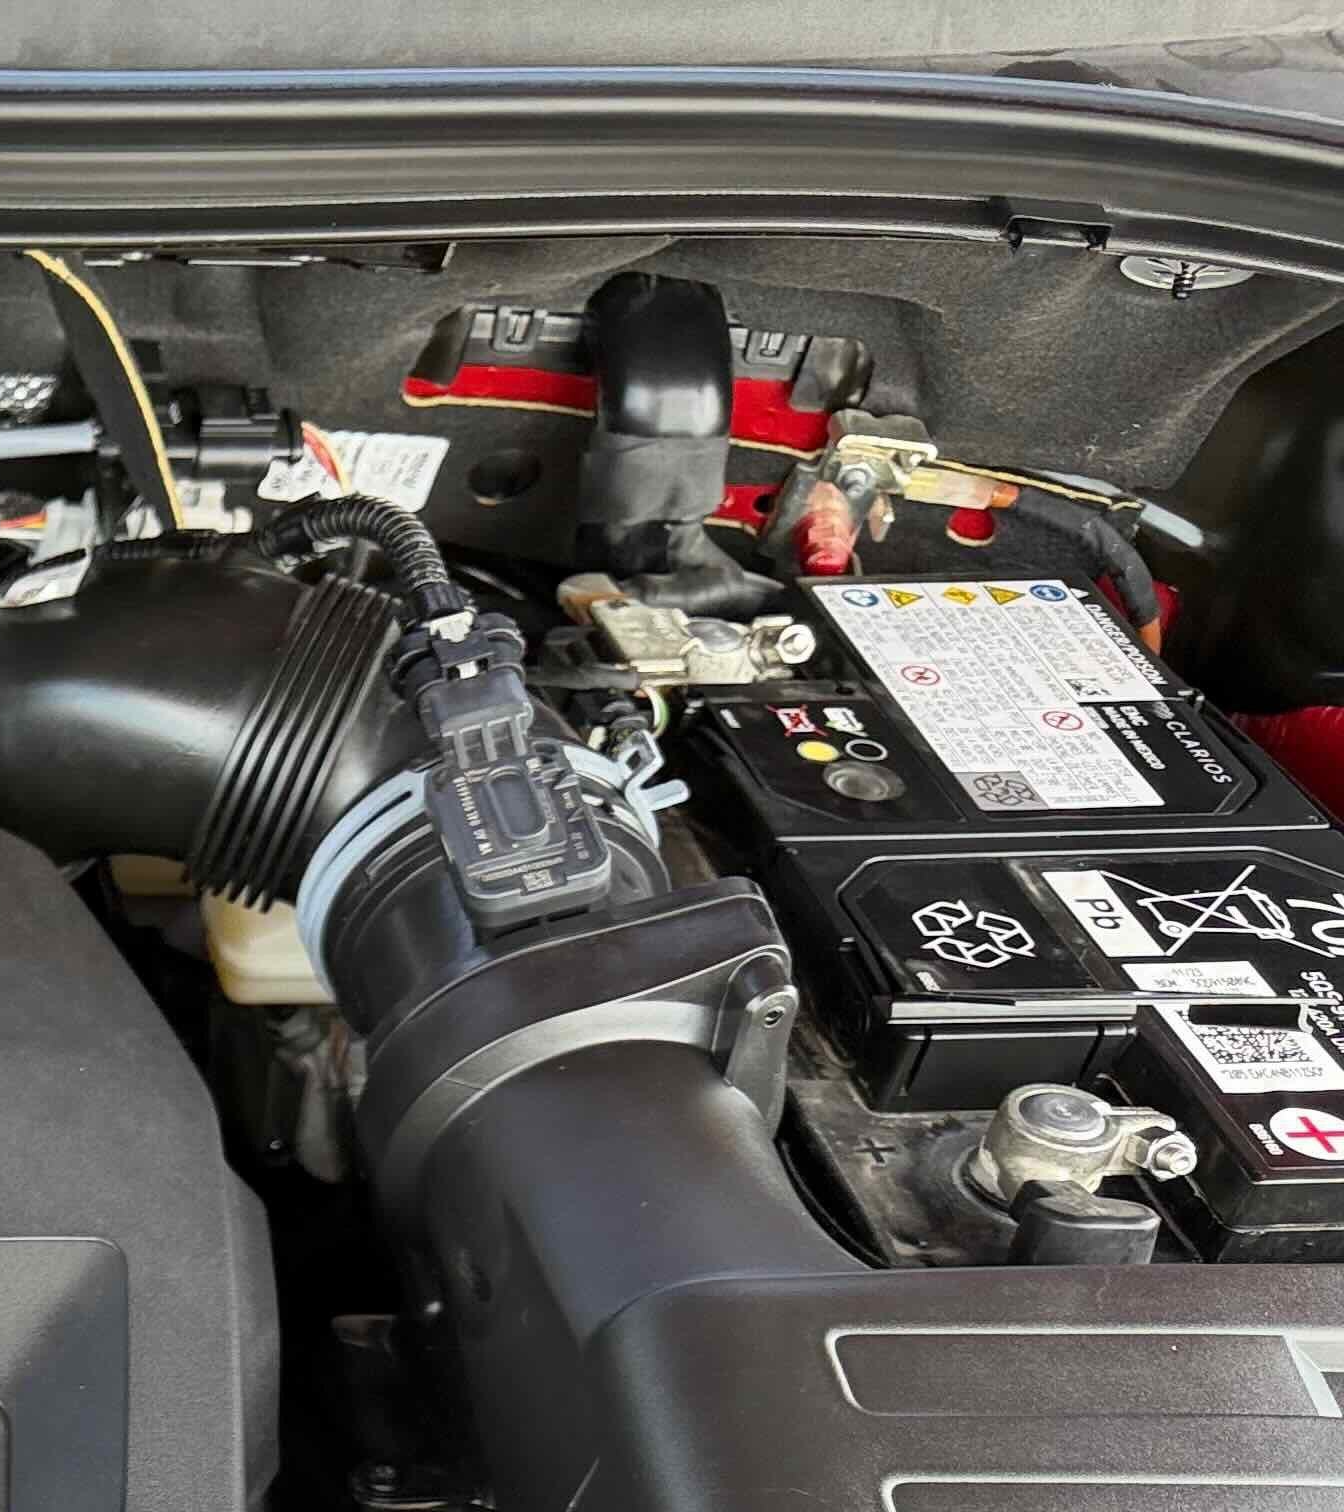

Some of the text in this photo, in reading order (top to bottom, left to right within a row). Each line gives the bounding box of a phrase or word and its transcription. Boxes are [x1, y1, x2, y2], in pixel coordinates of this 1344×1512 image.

[1085, 604, 1168, 685] DANGER/POISON
[1166, 720, 1233, 784] CLARIOS
[1073, 898, 1125, 931] Pb
